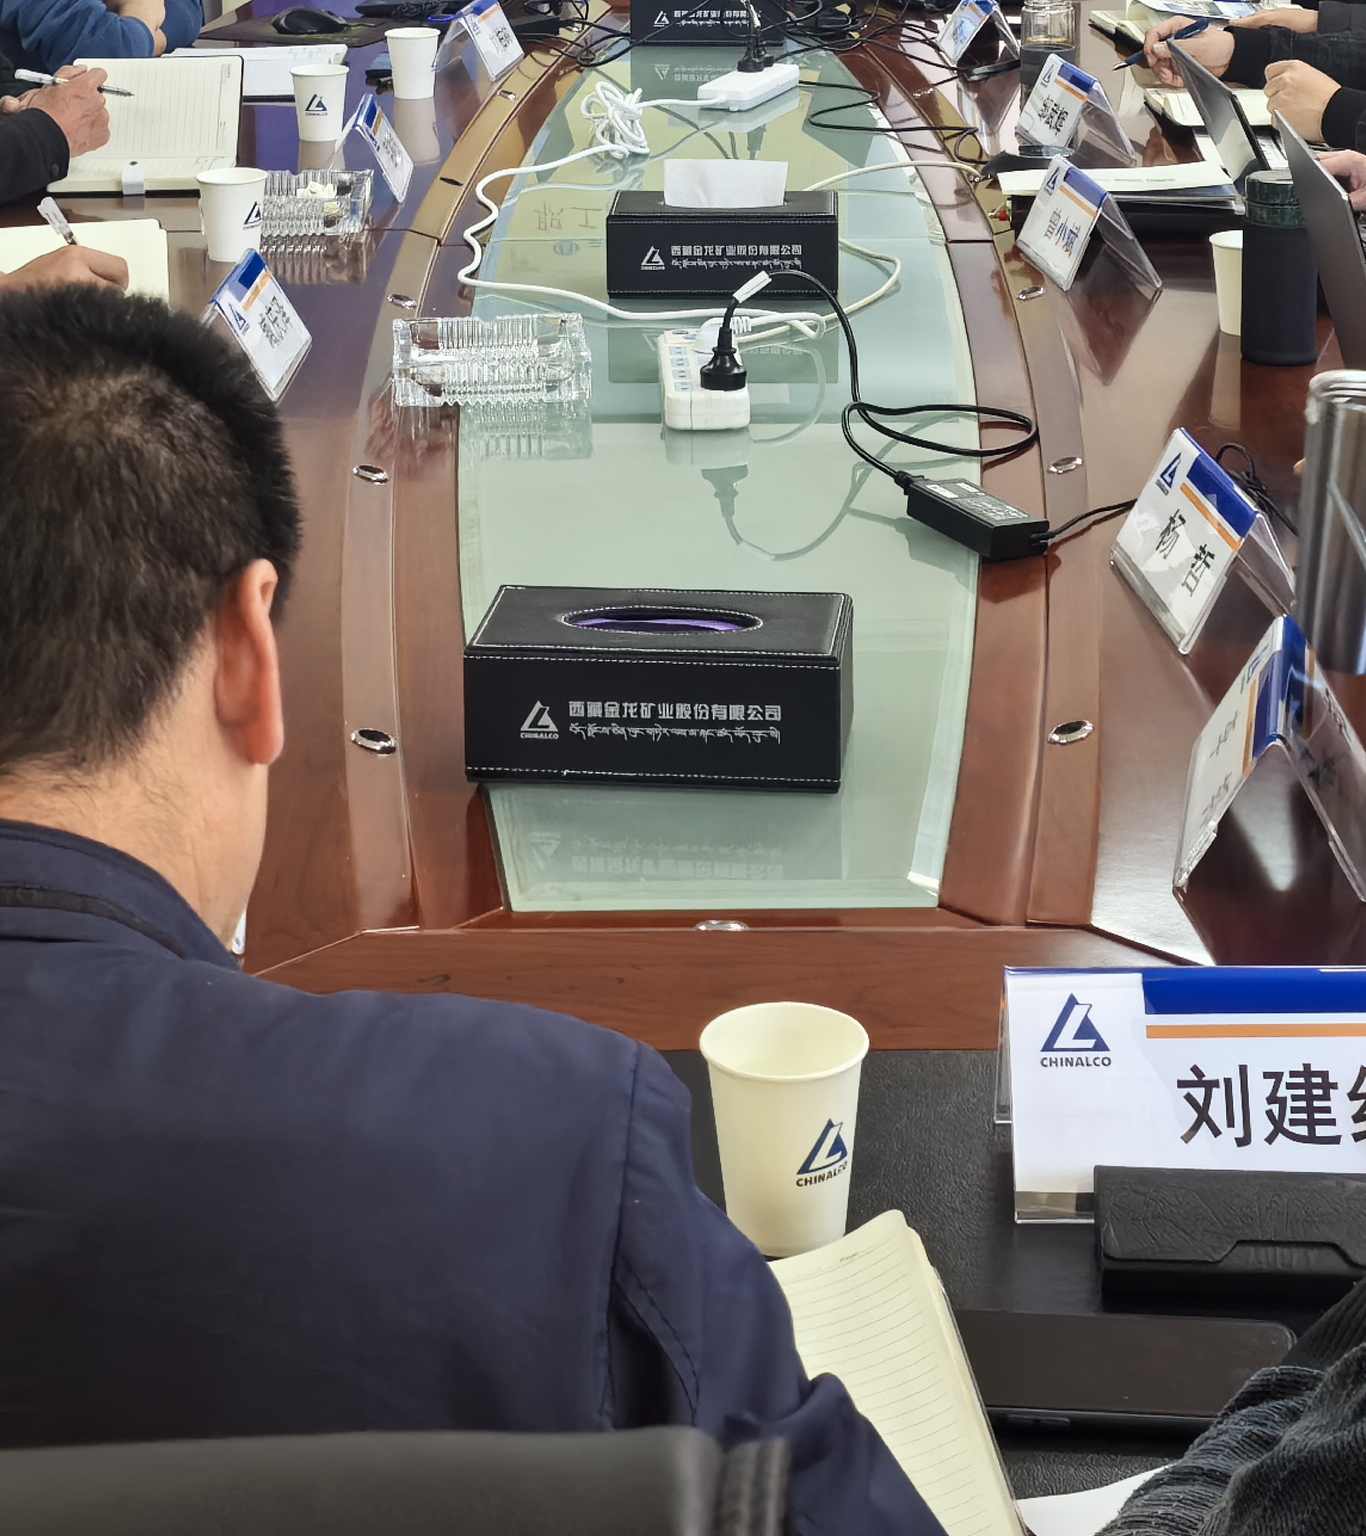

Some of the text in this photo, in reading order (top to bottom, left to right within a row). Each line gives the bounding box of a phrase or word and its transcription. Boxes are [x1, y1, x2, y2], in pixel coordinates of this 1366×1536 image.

[670, 244, 802, 257] 西藏金龙矿业股份有限公司
[568, 700, 782, 722] 西藏金龙矿业股份有限公司
[1040, 1056, 1112, 1068] CHINALCO
[795, 1159, 848, 1188] CHINALCO
